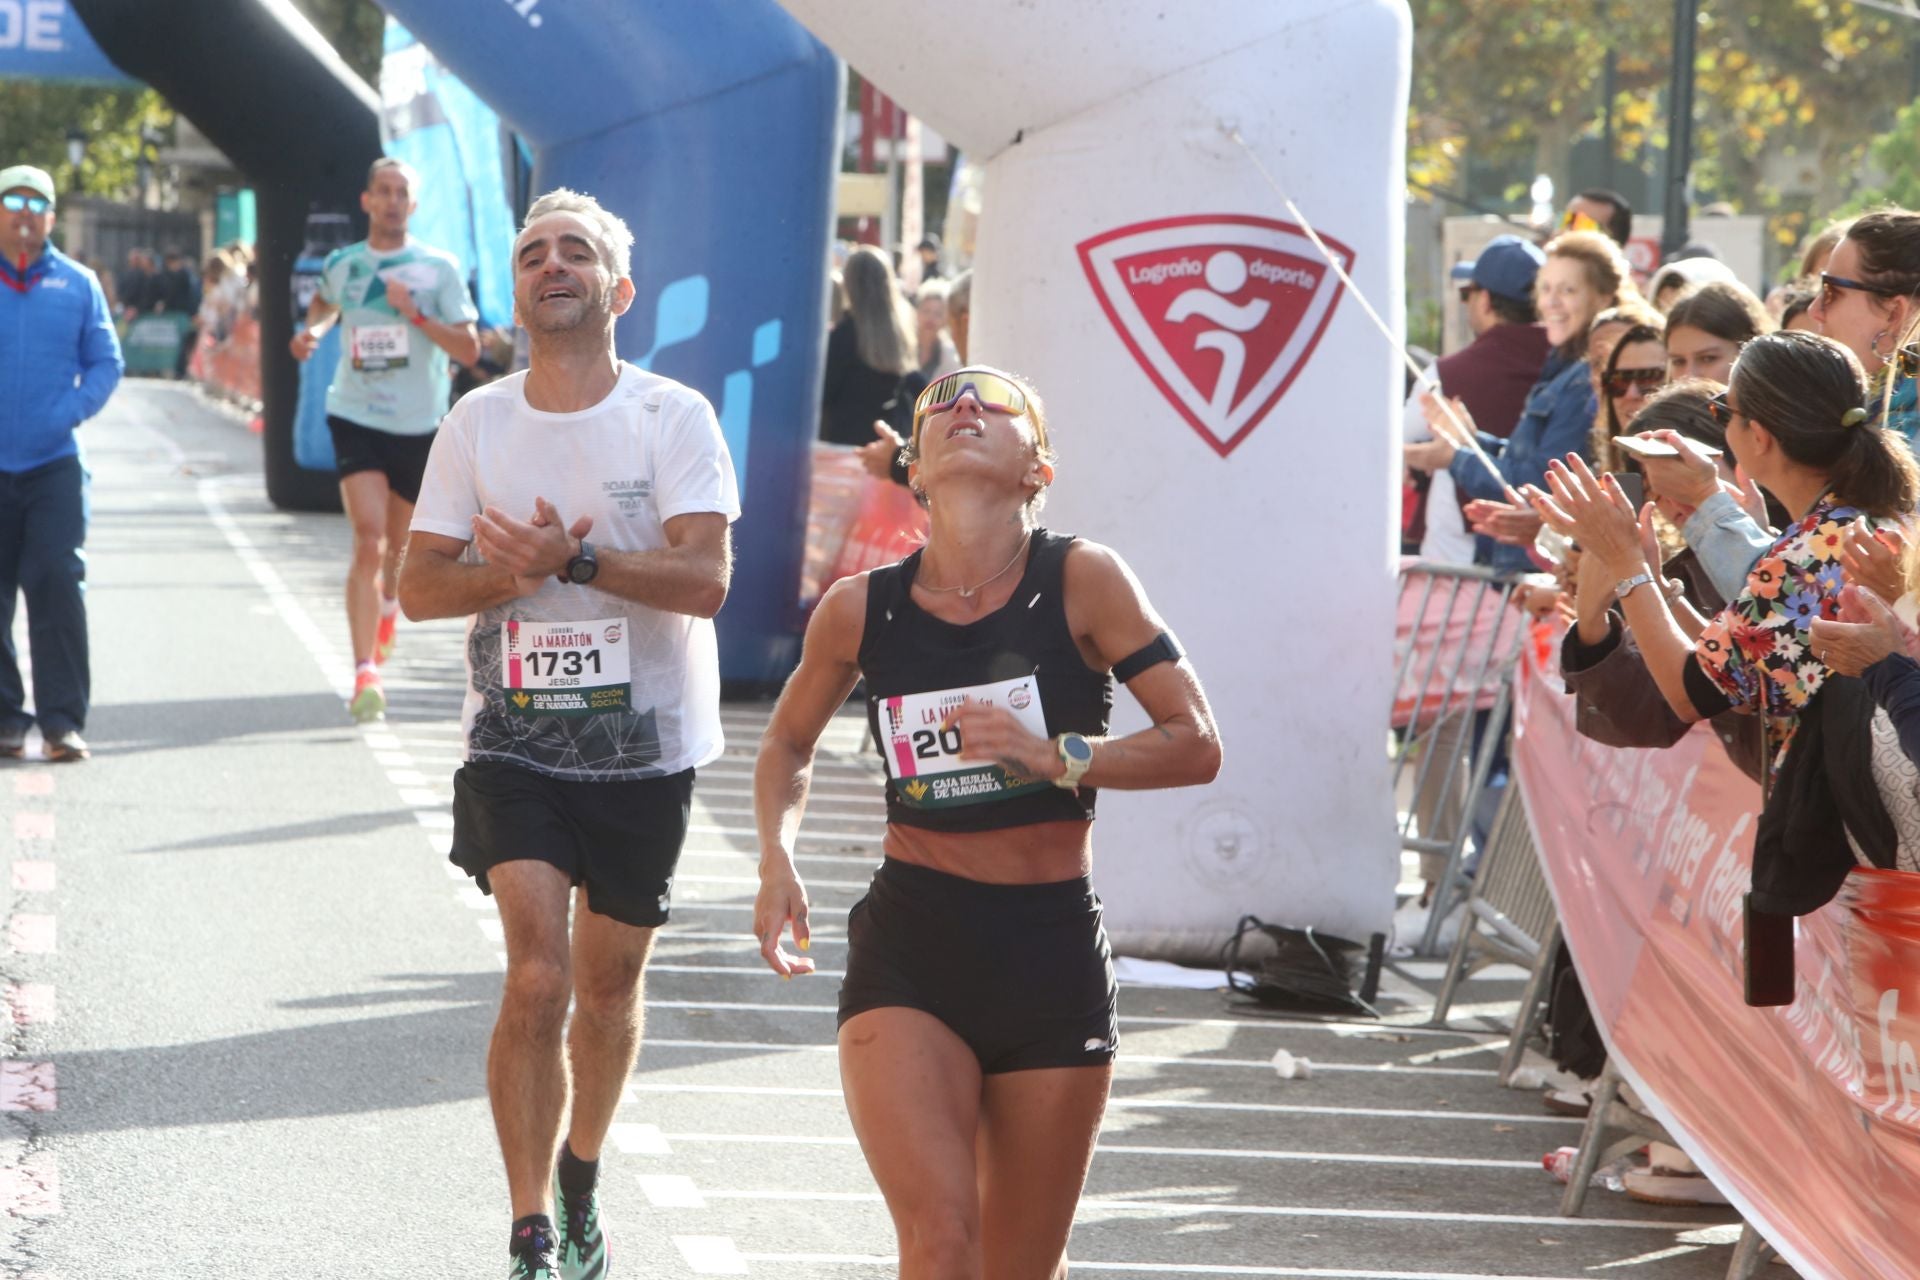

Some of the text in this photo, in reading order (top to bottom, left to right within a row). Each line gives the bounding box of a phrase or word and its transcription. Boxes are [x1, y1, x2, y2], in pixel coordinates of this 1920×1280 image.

[1129, 257, 1315, 289] Logroño deporte
[532, 635, 543, 648] LA
[546, 632, 593, 648] MARATÓN
[524, 649, 602, 676] 1731
[533, 693, 583, 702] CAJA RURAL
[534, 701, 588, 710] DE NAVARRA
[591, 699, 624, 708] SOCIAL
[921, 708, 937, 724] LA
[932, 778, 959, 790] CAJA
[960, 772, 995, 786] RURAL
[934, 788, 950, 800] DE
[951, 781, 1003, 798] NAVARRA
[1657, 764, 1717, 891] ferrer
[1700, 812, 1753, 938] ferre
